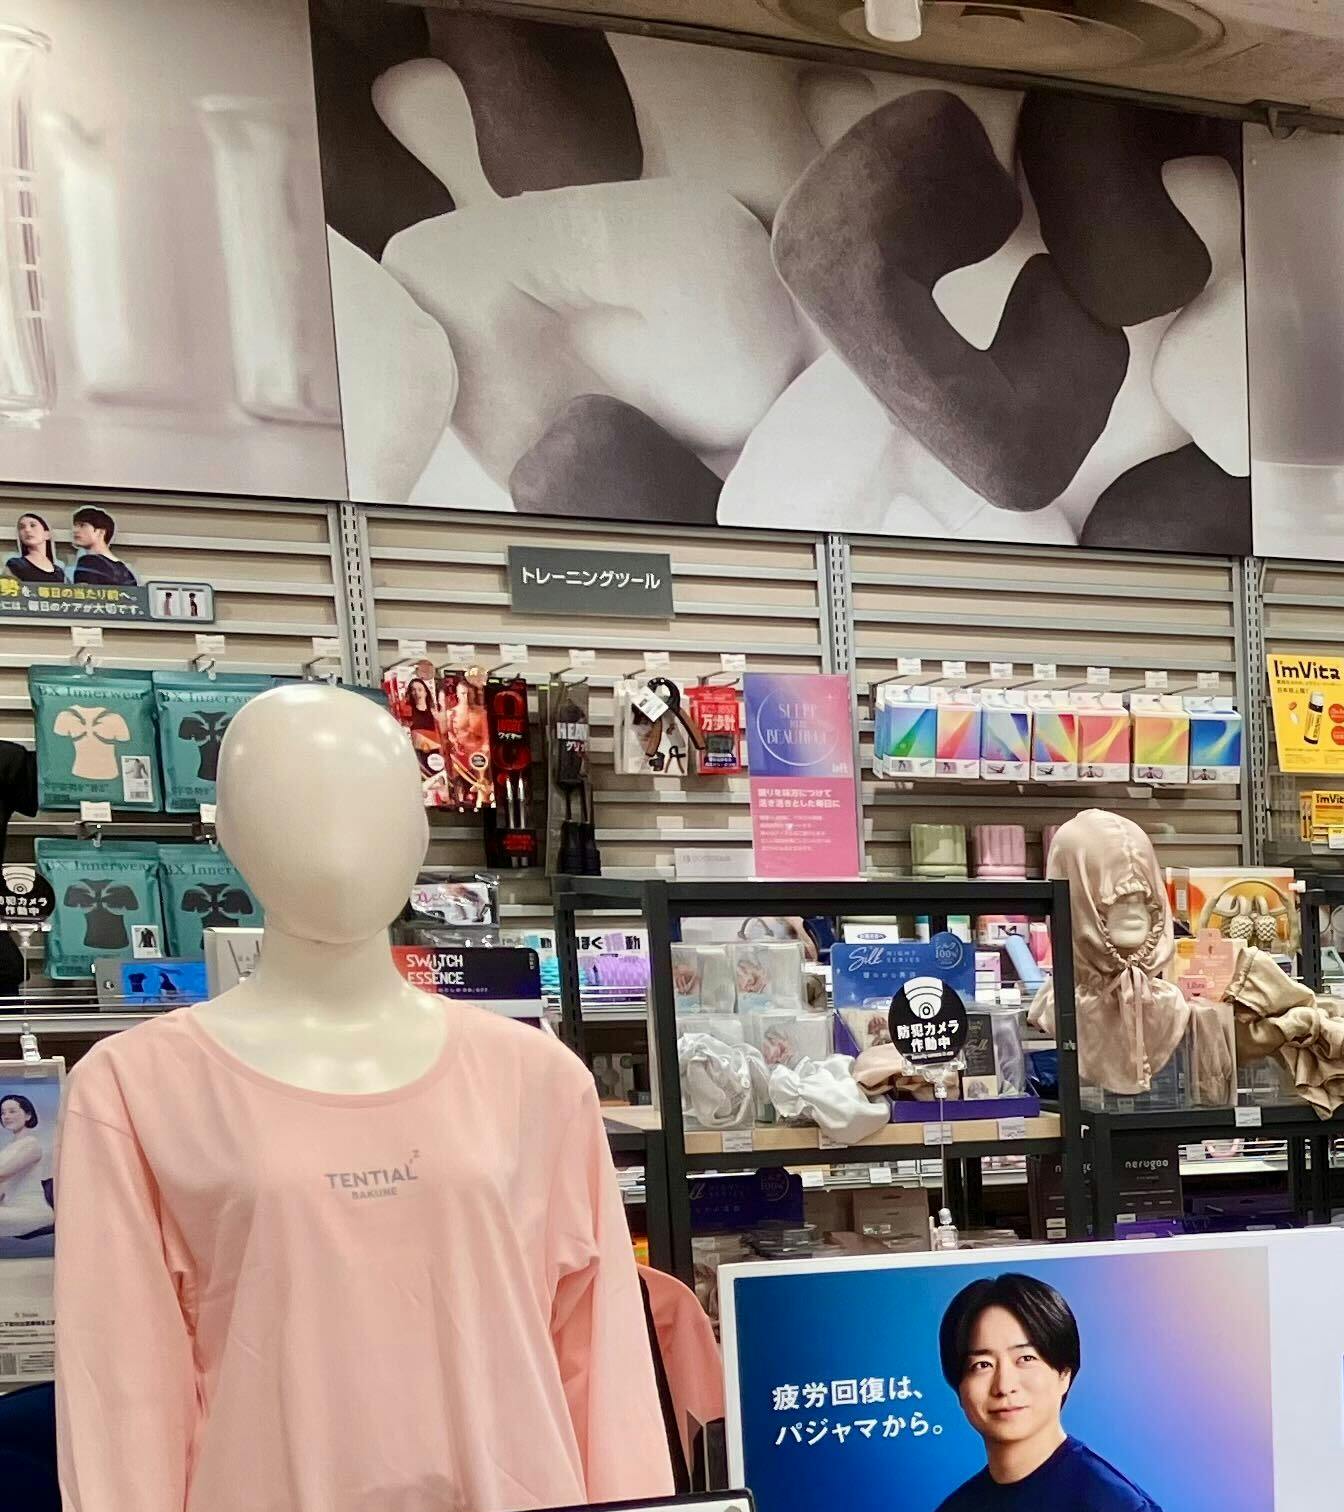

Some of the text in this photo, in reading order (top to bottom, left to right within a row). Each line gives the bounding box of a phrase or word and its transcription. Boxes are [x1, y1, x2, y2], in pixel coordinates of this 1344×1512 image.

[522, 566, 661, 590] トレーニングツール
[407, 971, 465, 985] ESSENCE
[897, 1020, 960, 1040] 防犯カメラ
[910, 1035, 951, 1053] 作動中
[324, 1162, 419, 1190] TENTIAL
[351, 1186, 398, 1200] BAKUNE
[771, 1375, 924, 1412] 疲労回復は、
[774, 1411, 944, 1446] パジャマから。
